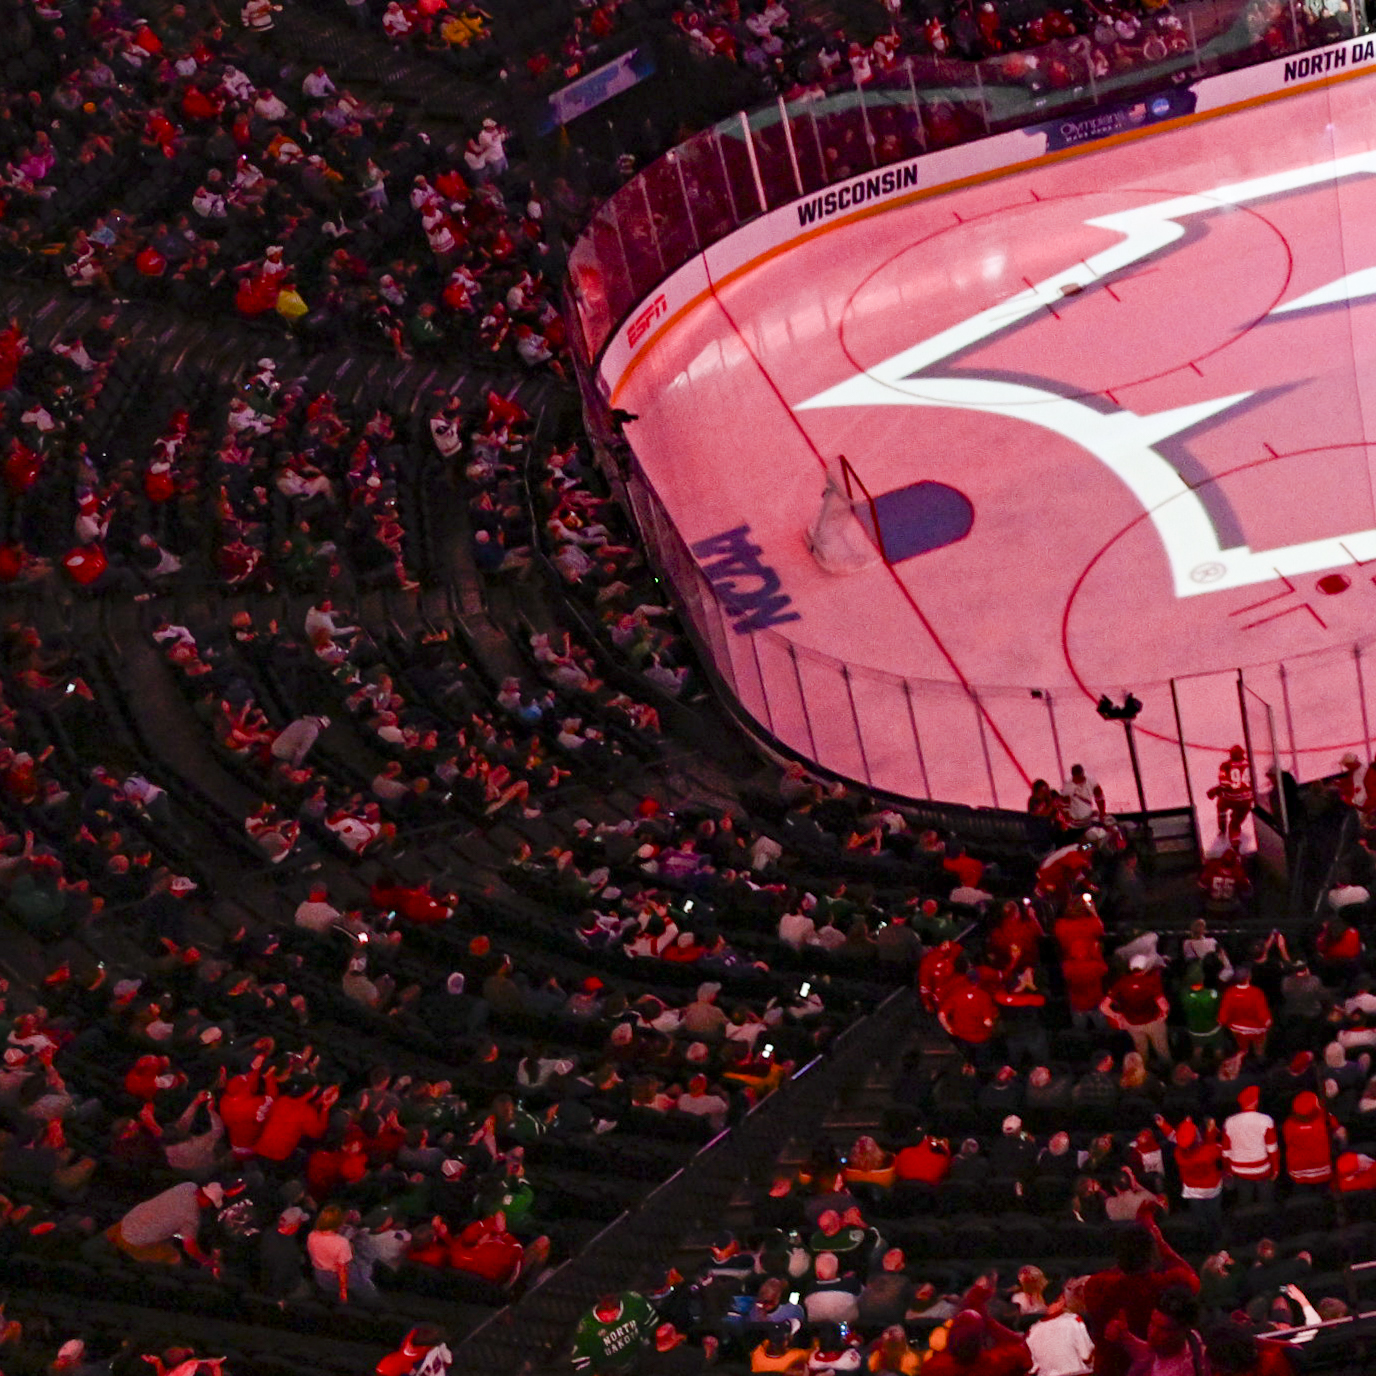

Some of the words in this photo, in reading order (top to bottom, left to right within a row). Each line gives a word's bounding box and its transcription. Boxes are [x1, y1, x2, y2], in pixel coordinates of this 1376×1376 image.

[1284, 45, 1346, 82] NORTH
[797, 163, 918, 227] WISCONSIN
[627, 293, 669, 350] ESPN
[603, 1320, 637, 1346] NORTH
